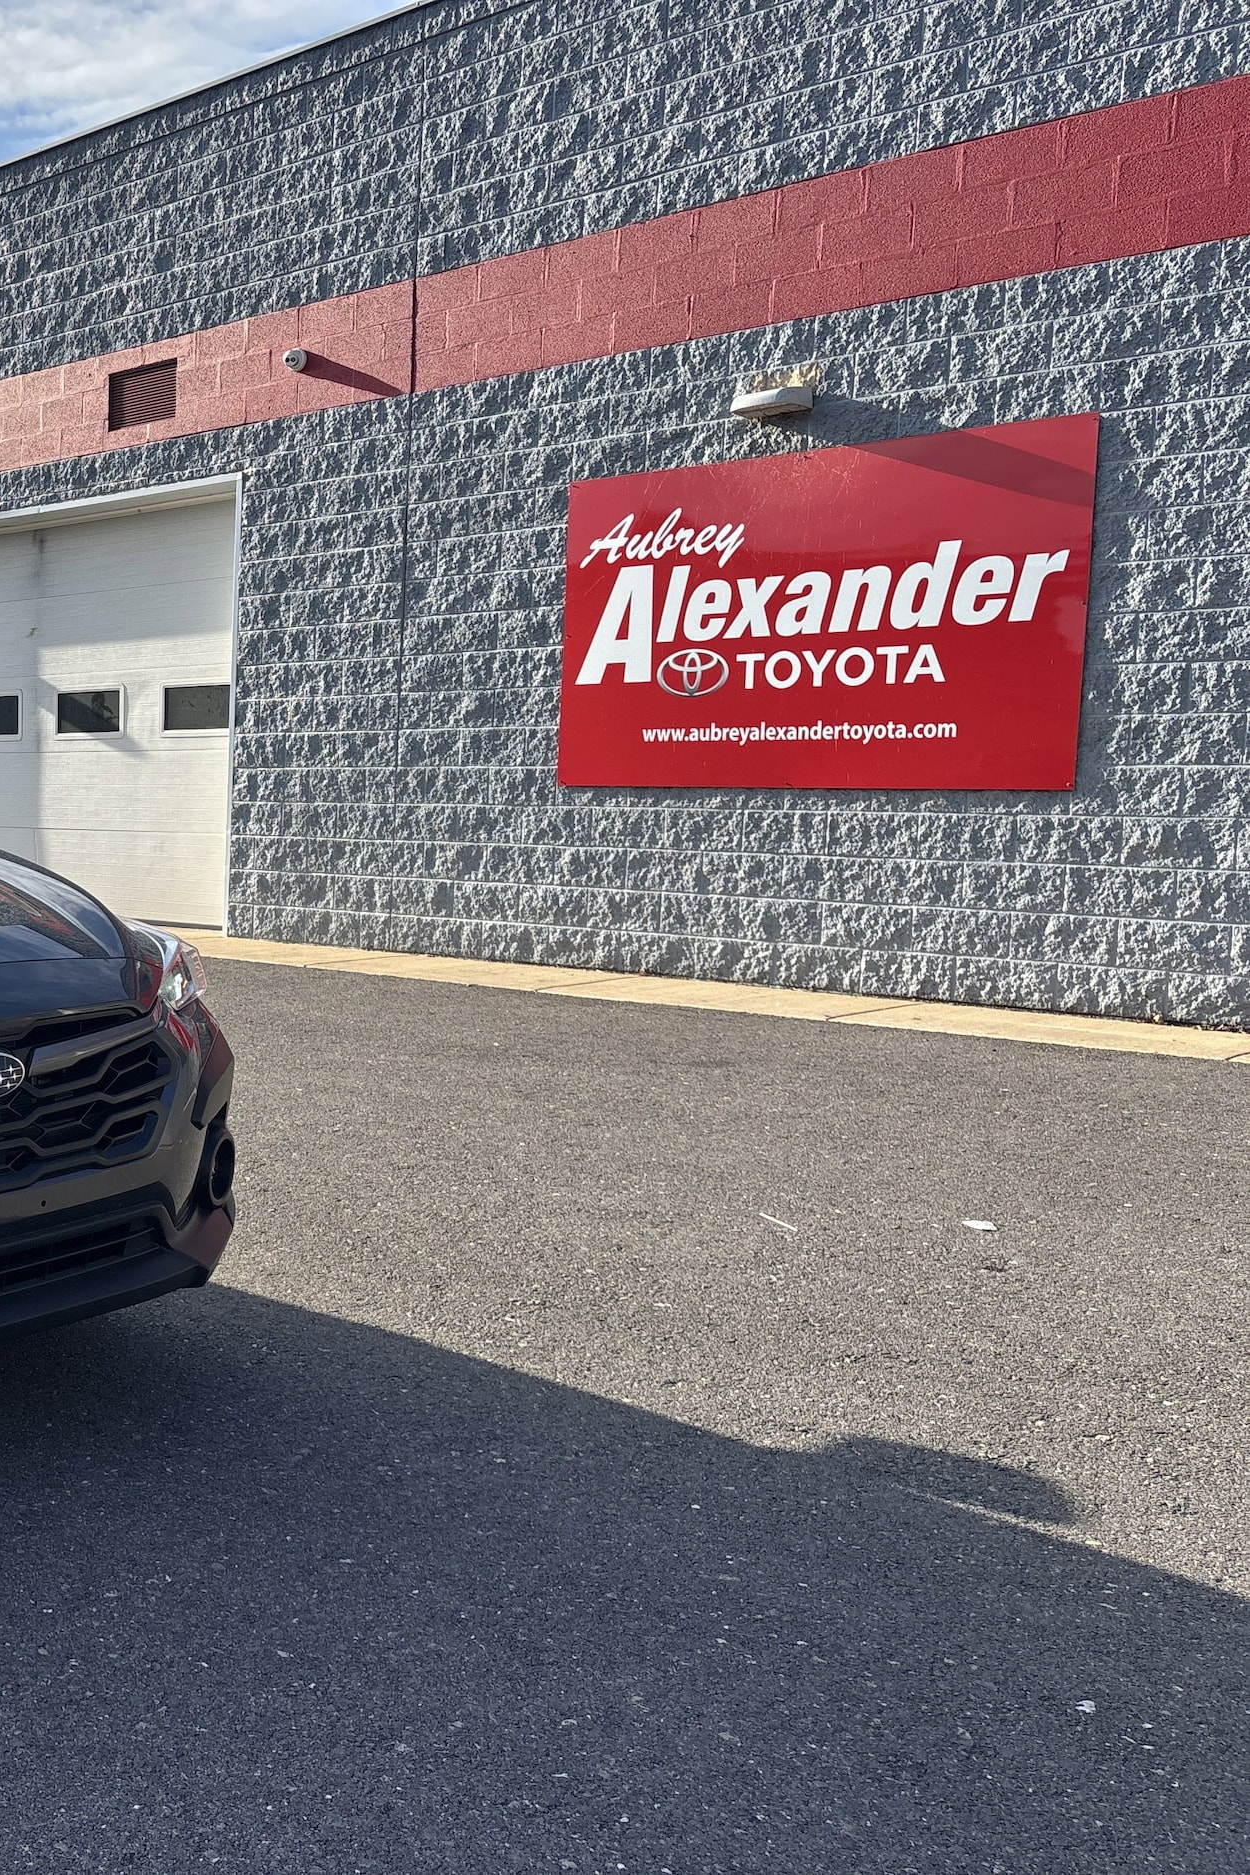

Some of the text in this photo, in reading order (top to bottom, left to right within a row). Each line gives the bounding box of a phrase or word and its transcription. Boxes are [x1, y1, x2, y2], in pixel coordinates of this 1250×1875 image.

[579, 507, 745, 569] Aubrey
[574, 539, 1071, 686] Alexander
[735, 643, 946, 690] TOYOTA
[642, 720, 957, 746] www.aubreyalexandertoyota.com
